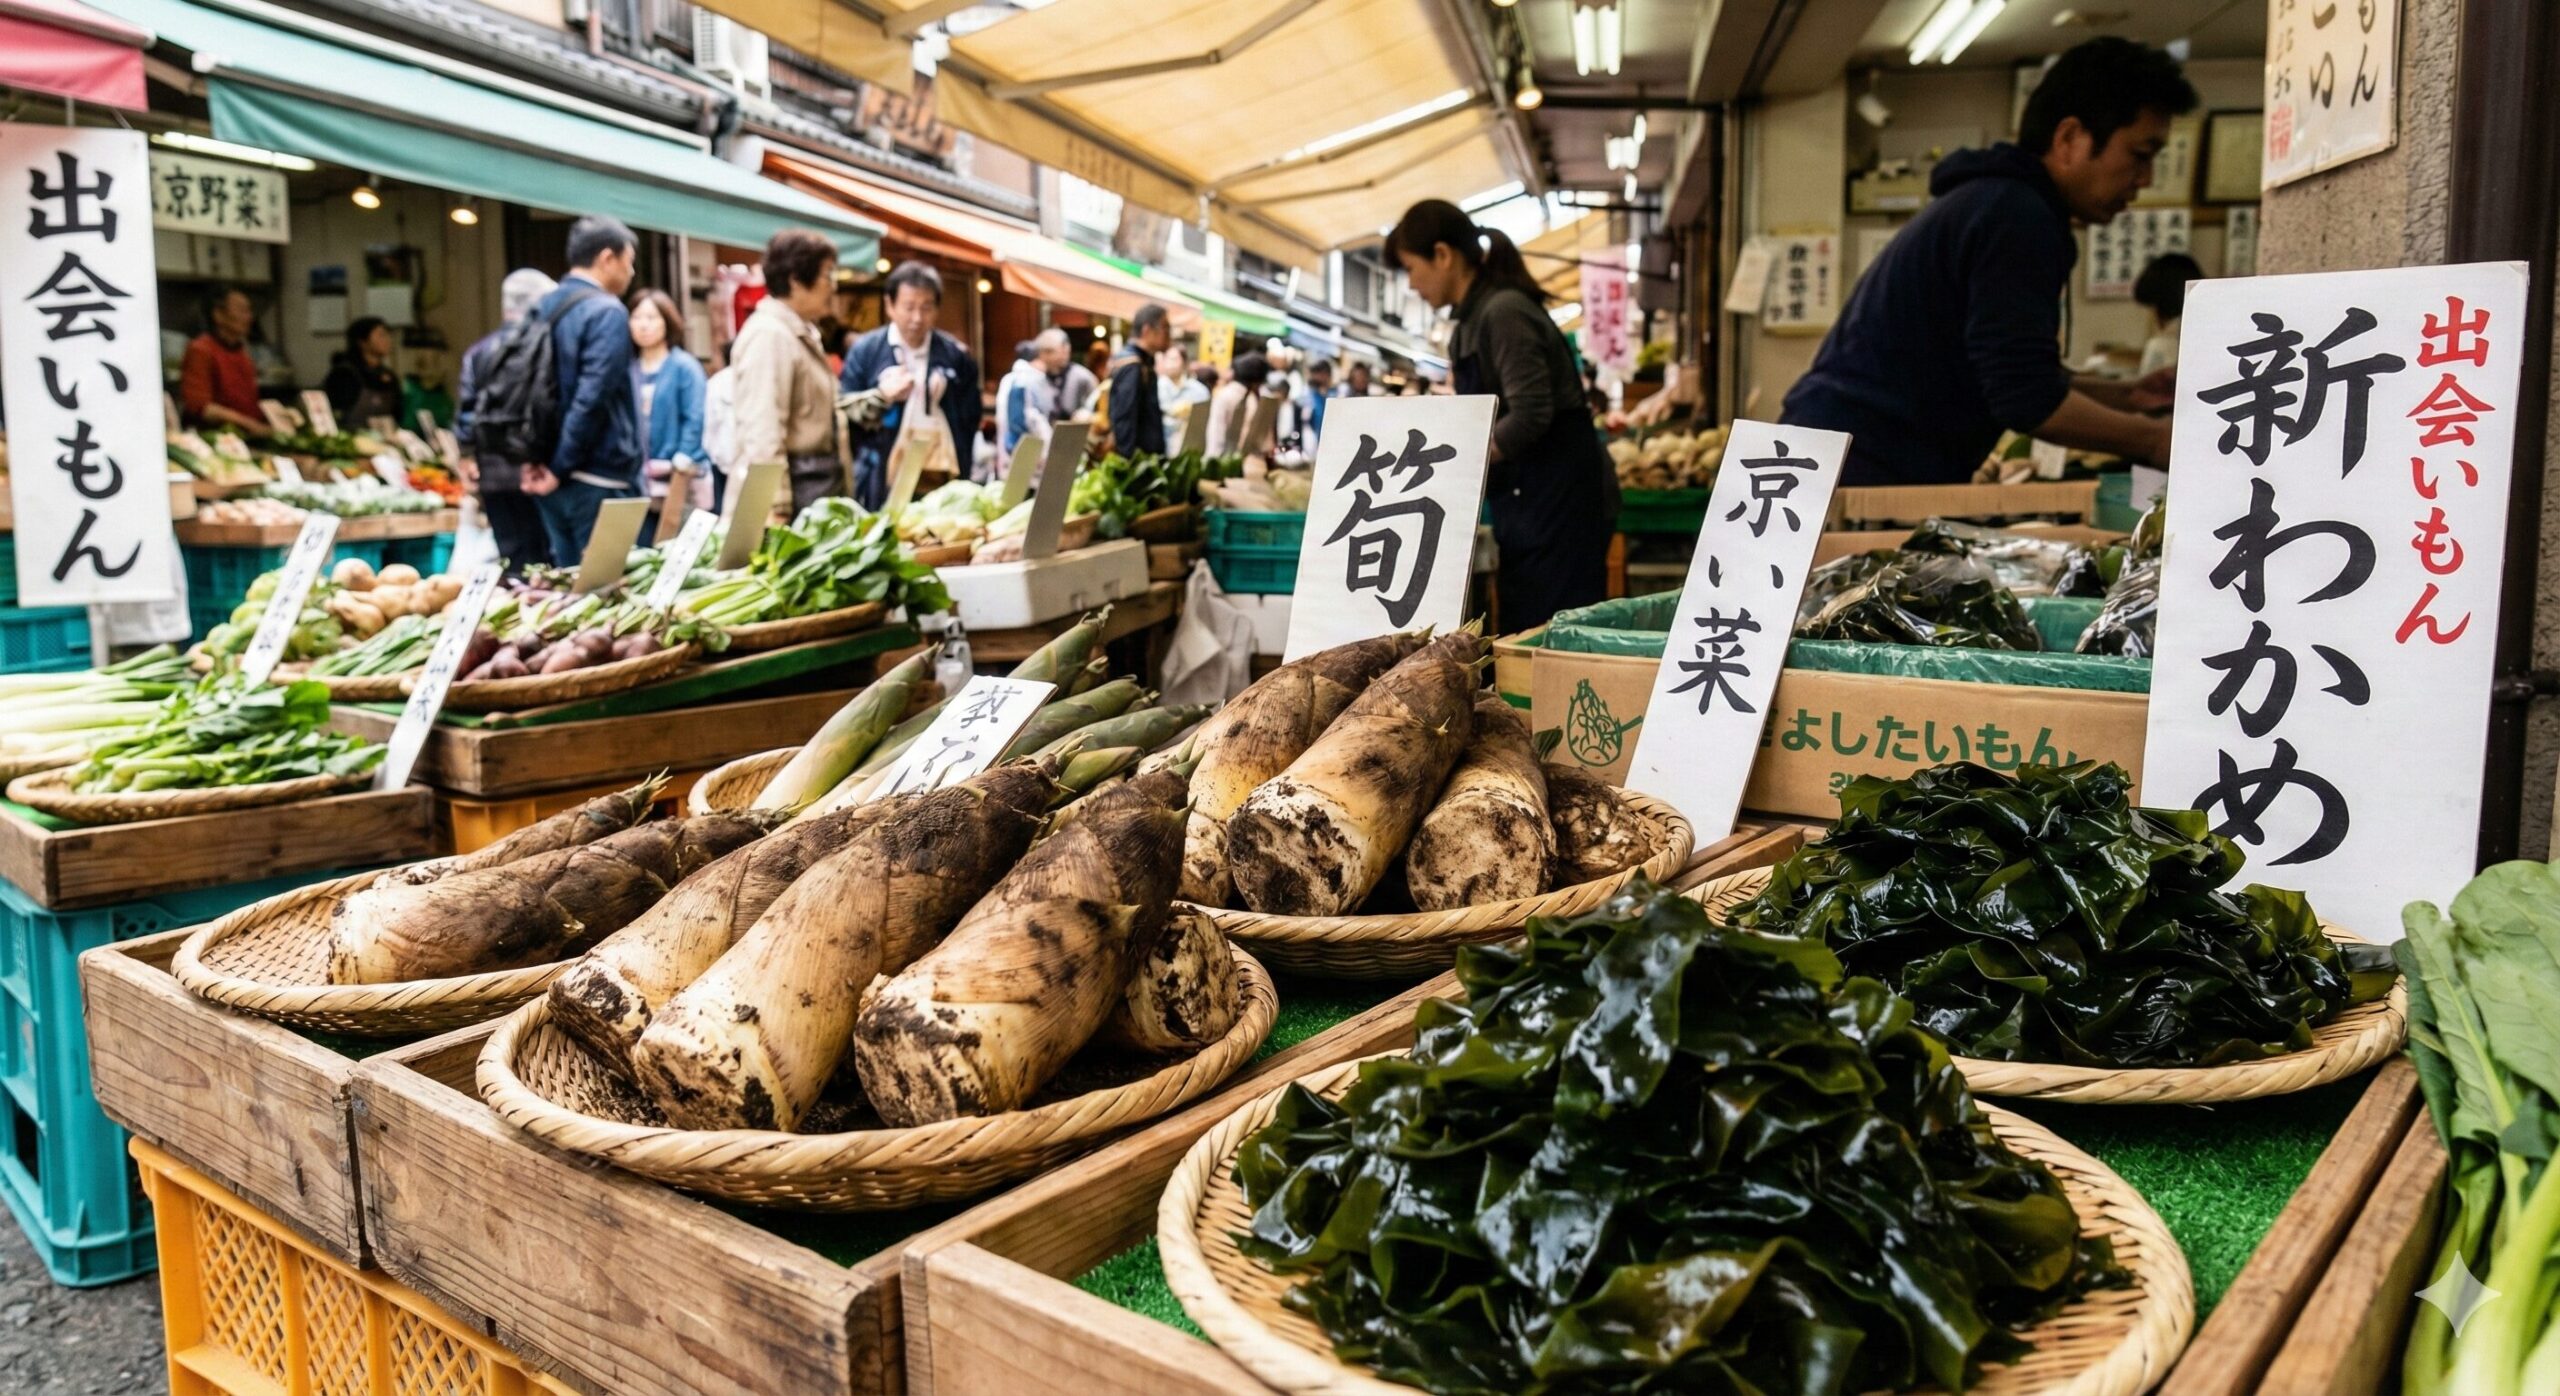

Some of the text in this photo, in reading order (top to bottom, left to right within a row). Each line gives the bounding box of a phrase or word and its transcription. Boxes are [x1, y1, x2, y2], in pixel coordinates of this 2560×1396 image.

[151, 164, 262, 229] 京野菜
[28, 151, 140, 582] 出会いもん
[2395, 296, 2496, 645] 出会いもん
[1322, 428, 1457, 628] 筍
[1666, 440, 1819, 714] 京い菜
[2191, 307, 2407, 866] 新わかめ
[1761, 708, 2078, 771] よしたいもん
